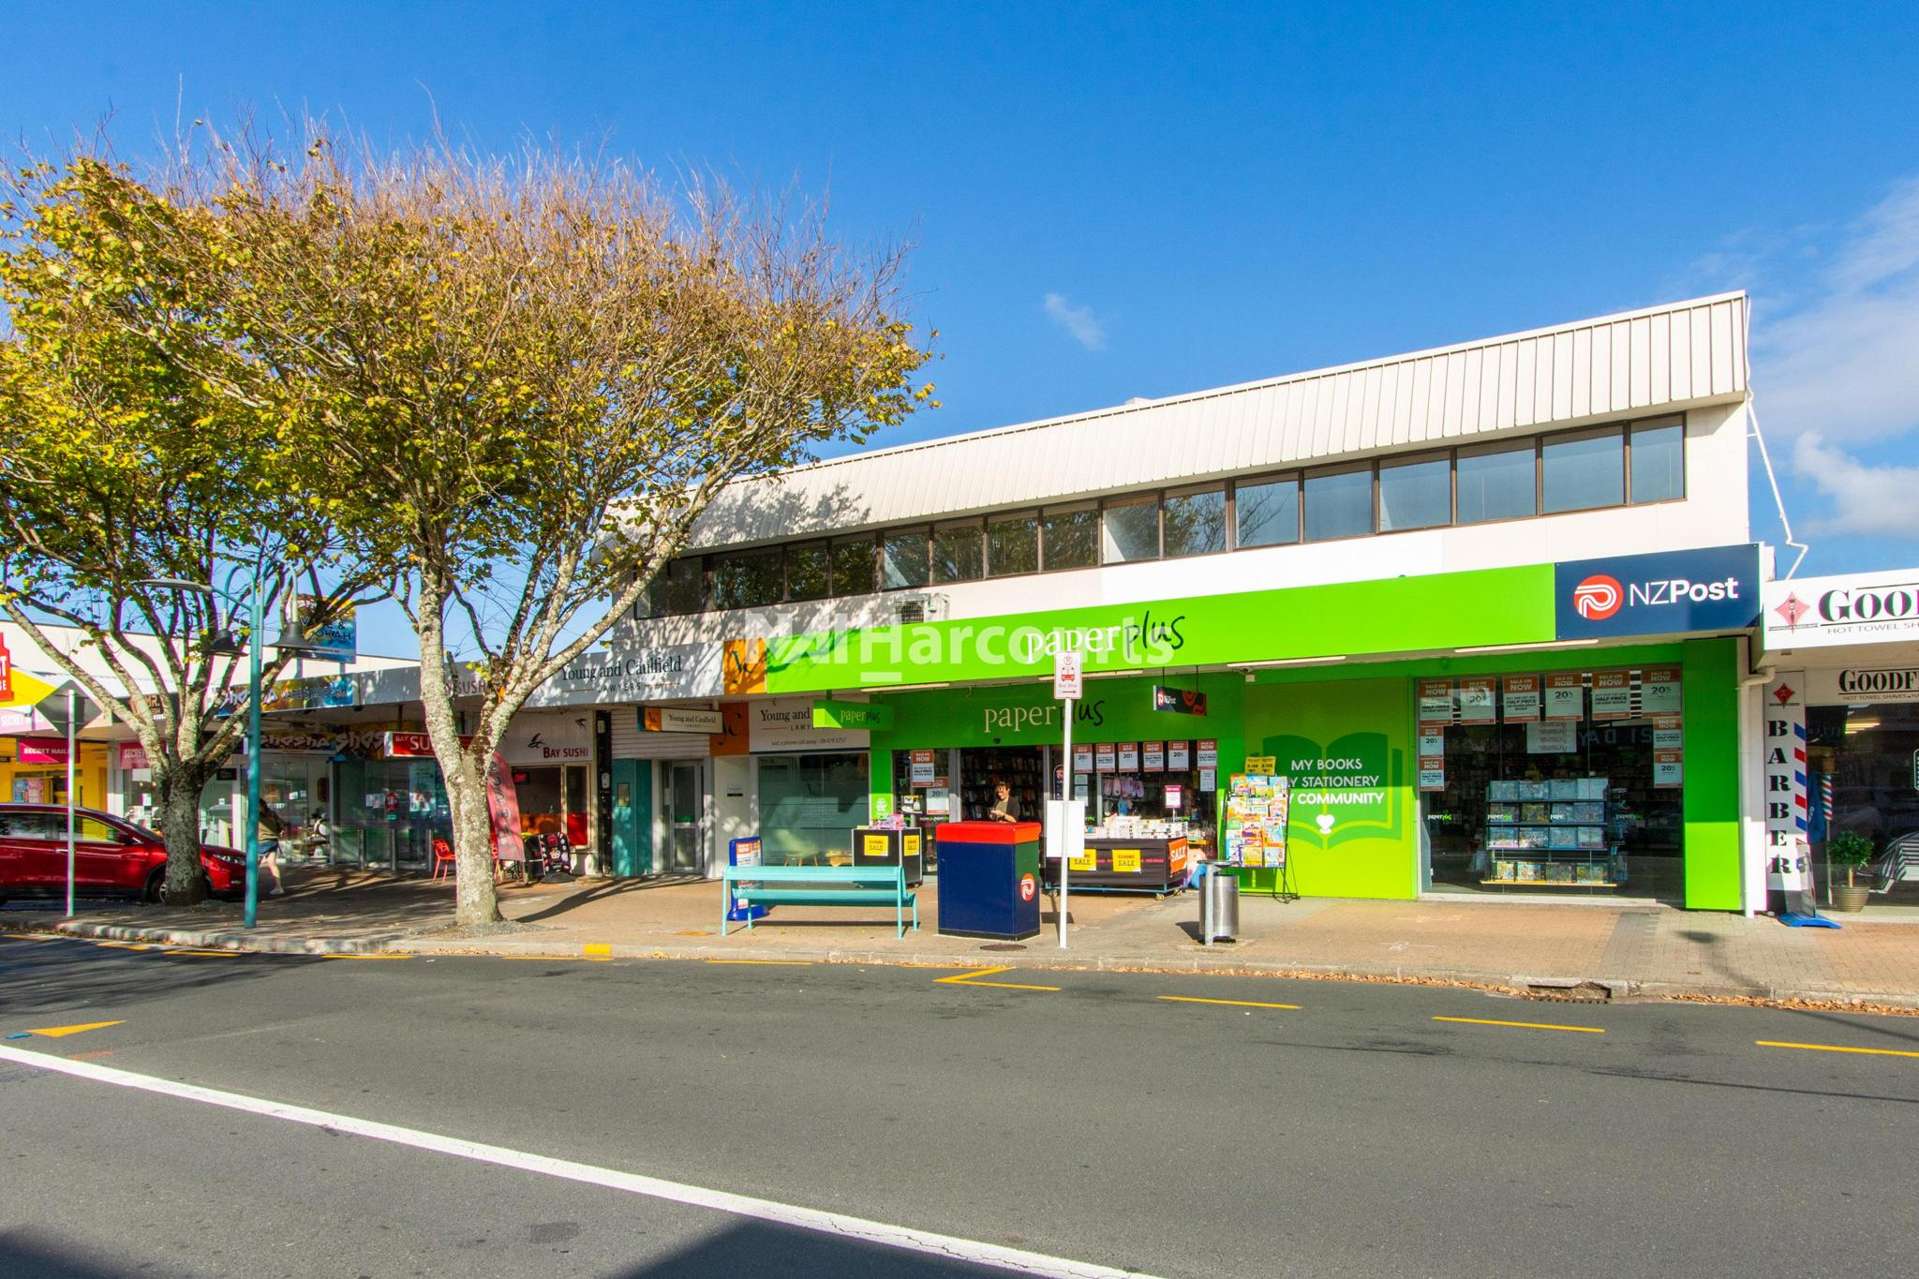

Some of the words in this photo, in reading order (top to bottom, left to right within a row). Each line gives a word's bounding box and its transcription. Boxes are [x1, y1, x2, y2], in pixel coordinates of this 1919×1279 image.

[1818, 589, 1919, 621] GOO
[1827, 626, 1854, 635] HOT
[1859, 624, 1898, 633] TOWEL
[561, 666, 596, 681] Young
[600, 660, 621, 677] and
[626, 655, 682, 676] Caulfield
[1510, 683, 1533, 691] NOW
[1598, 679, 1623, 687] NOW
[1838, 670, 1919, 692] GOODF
[1425, 688, 1446, 696] NOW
[761, 708, 791, 722] Young
[792, 707, 811, 720] and
[840, 709, 866, 724] paper
[984, 705, 1057, 733] paper
[543, 746, 561, 759] BAY
[562, 746, 589, 757] SUSHI
[1291, 759, 1313, 771] MY
[1317, 759, 1363, 770] BOOKS
[1302, 776, 1379, 788] STATIONERY
[1297, 792, 1384, 805] COMMUNITY
[1768, 720, 1791, 874] BARBER
[1171, 847, 1186, 859] SALE
